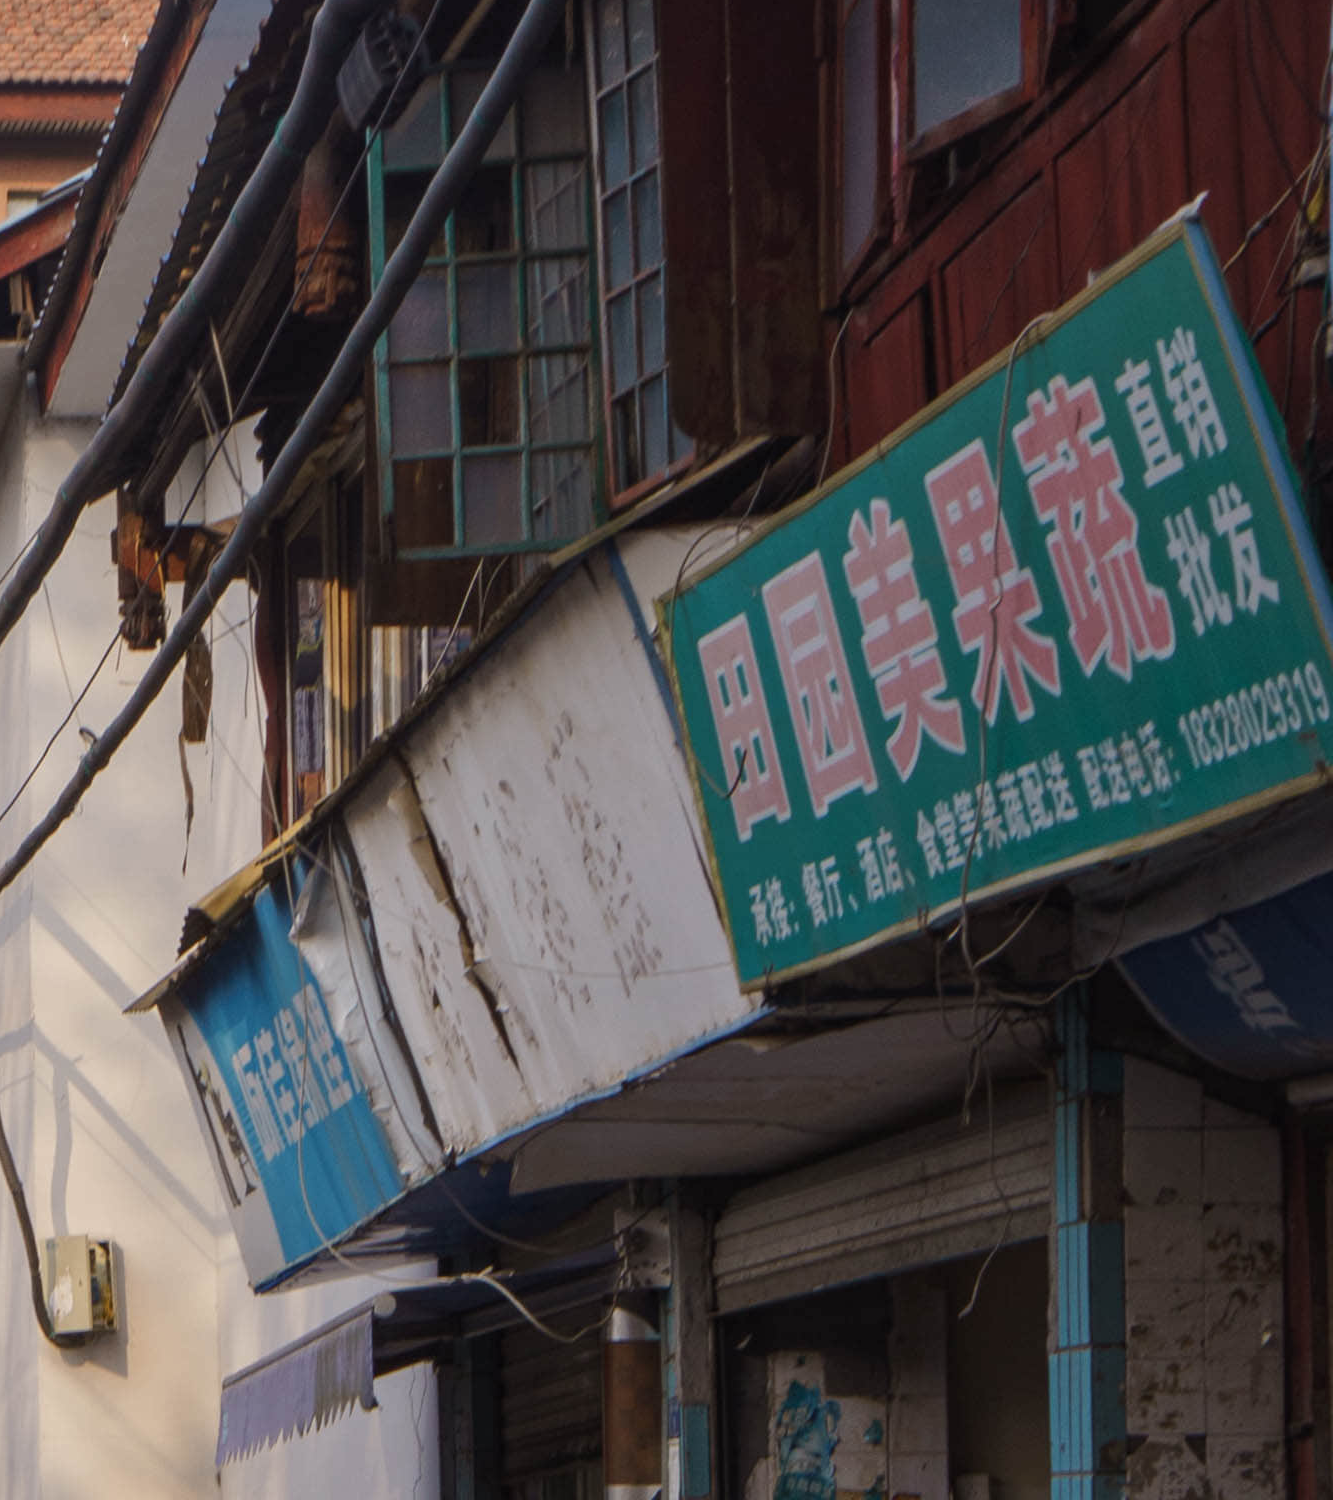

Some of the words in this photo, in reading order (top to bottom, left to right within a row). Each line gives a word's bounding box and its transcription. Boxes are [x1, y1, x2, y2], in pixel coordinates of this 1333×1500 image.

[1116, 328, 1228, 486] 直销
[698, 375, 1175, 841] 田园美果蔬
[1164, 484, 1279, 637] 批发
